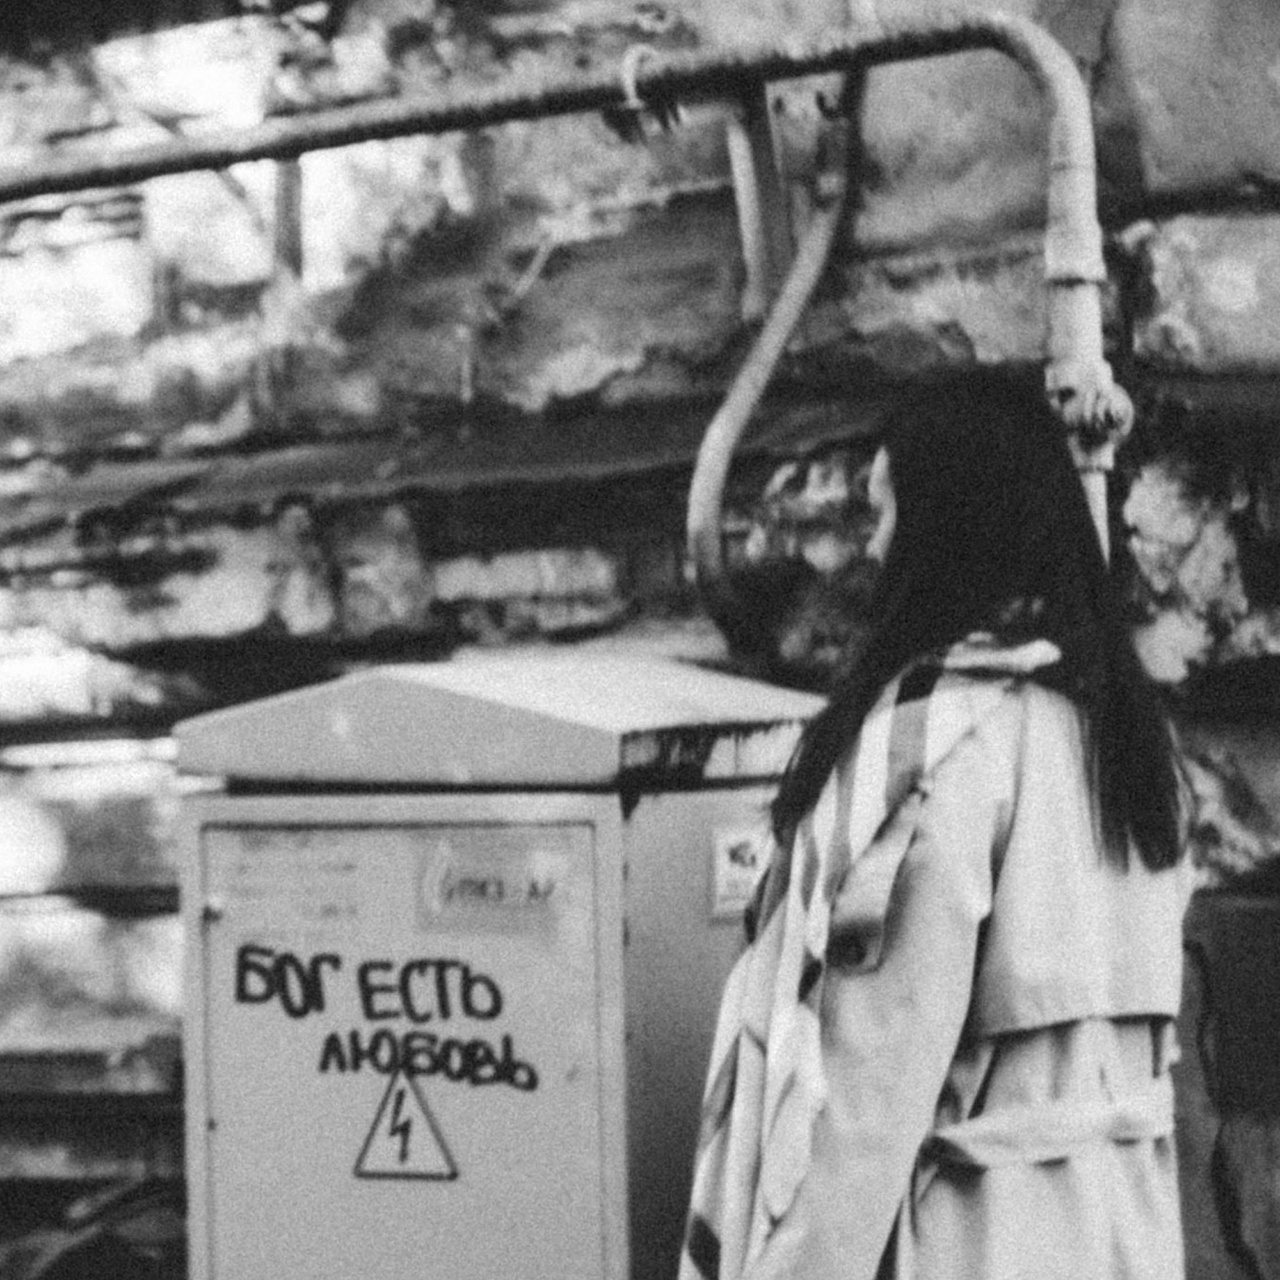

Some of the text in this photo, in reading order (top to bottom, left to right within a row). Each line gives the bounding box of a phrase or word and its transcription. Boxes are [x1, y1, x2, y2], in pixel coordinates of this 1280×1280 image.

[235, 944, 504, 1022] БОГ ЕСТЬ
[319, 1028, 539, 1092] ЛЮБОВЬ
